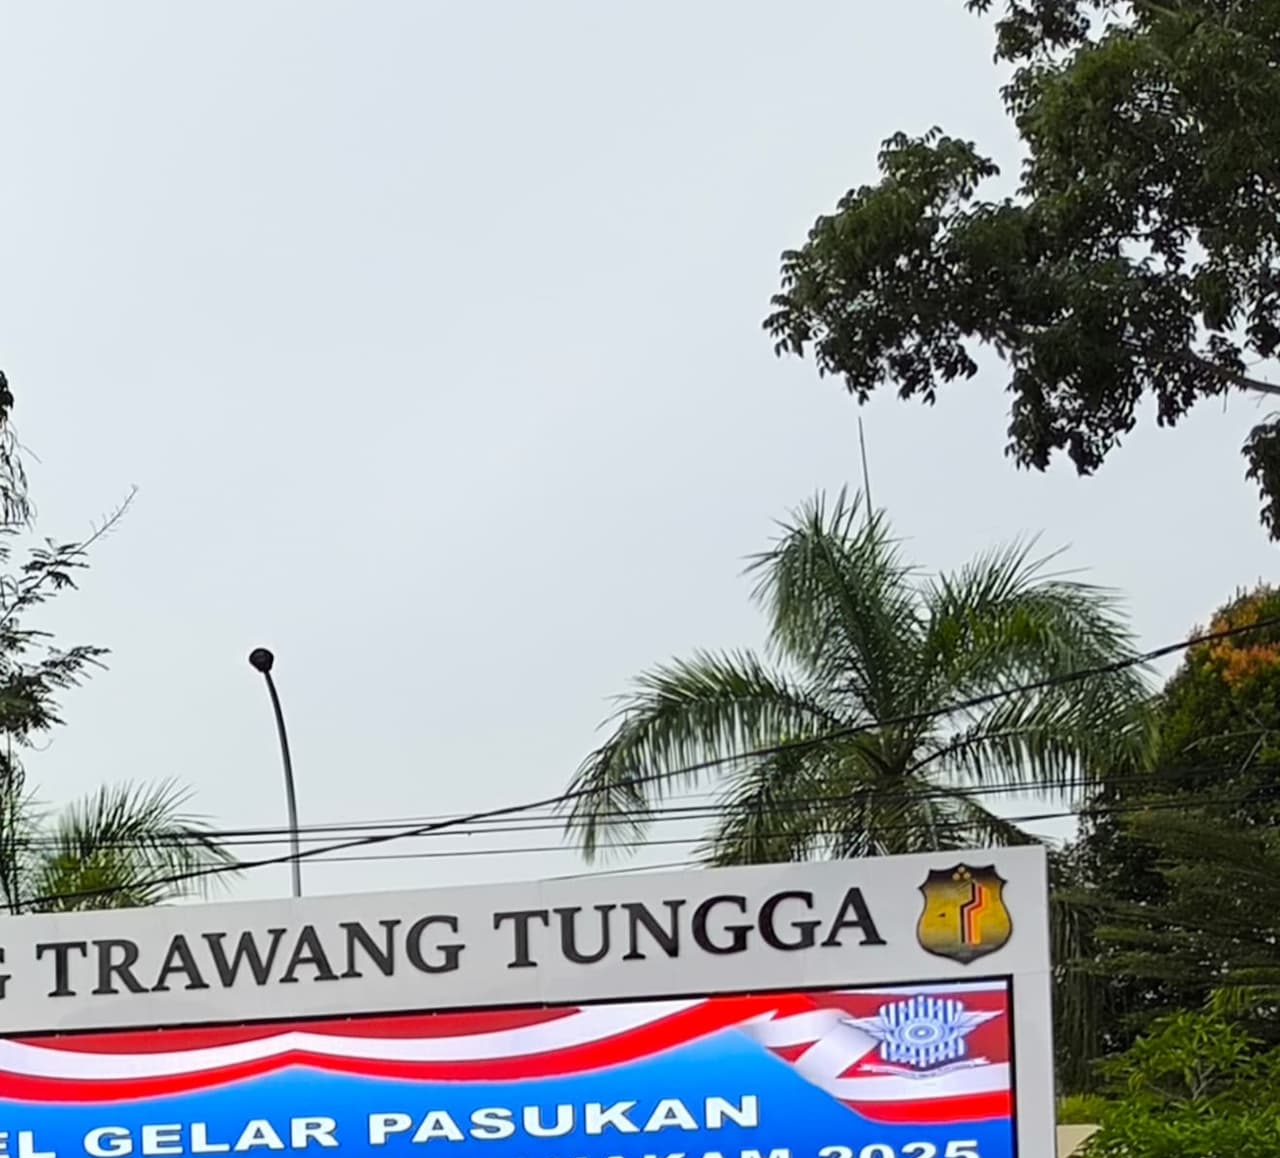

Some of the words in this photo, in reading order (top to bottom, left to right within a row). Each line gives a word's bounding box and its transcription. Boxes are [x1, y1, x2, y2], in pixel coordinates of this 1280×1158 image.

[35, 912, 467, 1000] TRAWANG
[493, 886, 889, 970] TUNGGA
[83, 1116, 339, 1158] GELAR
[368, 1095, 761, 1146] PASUKAN
